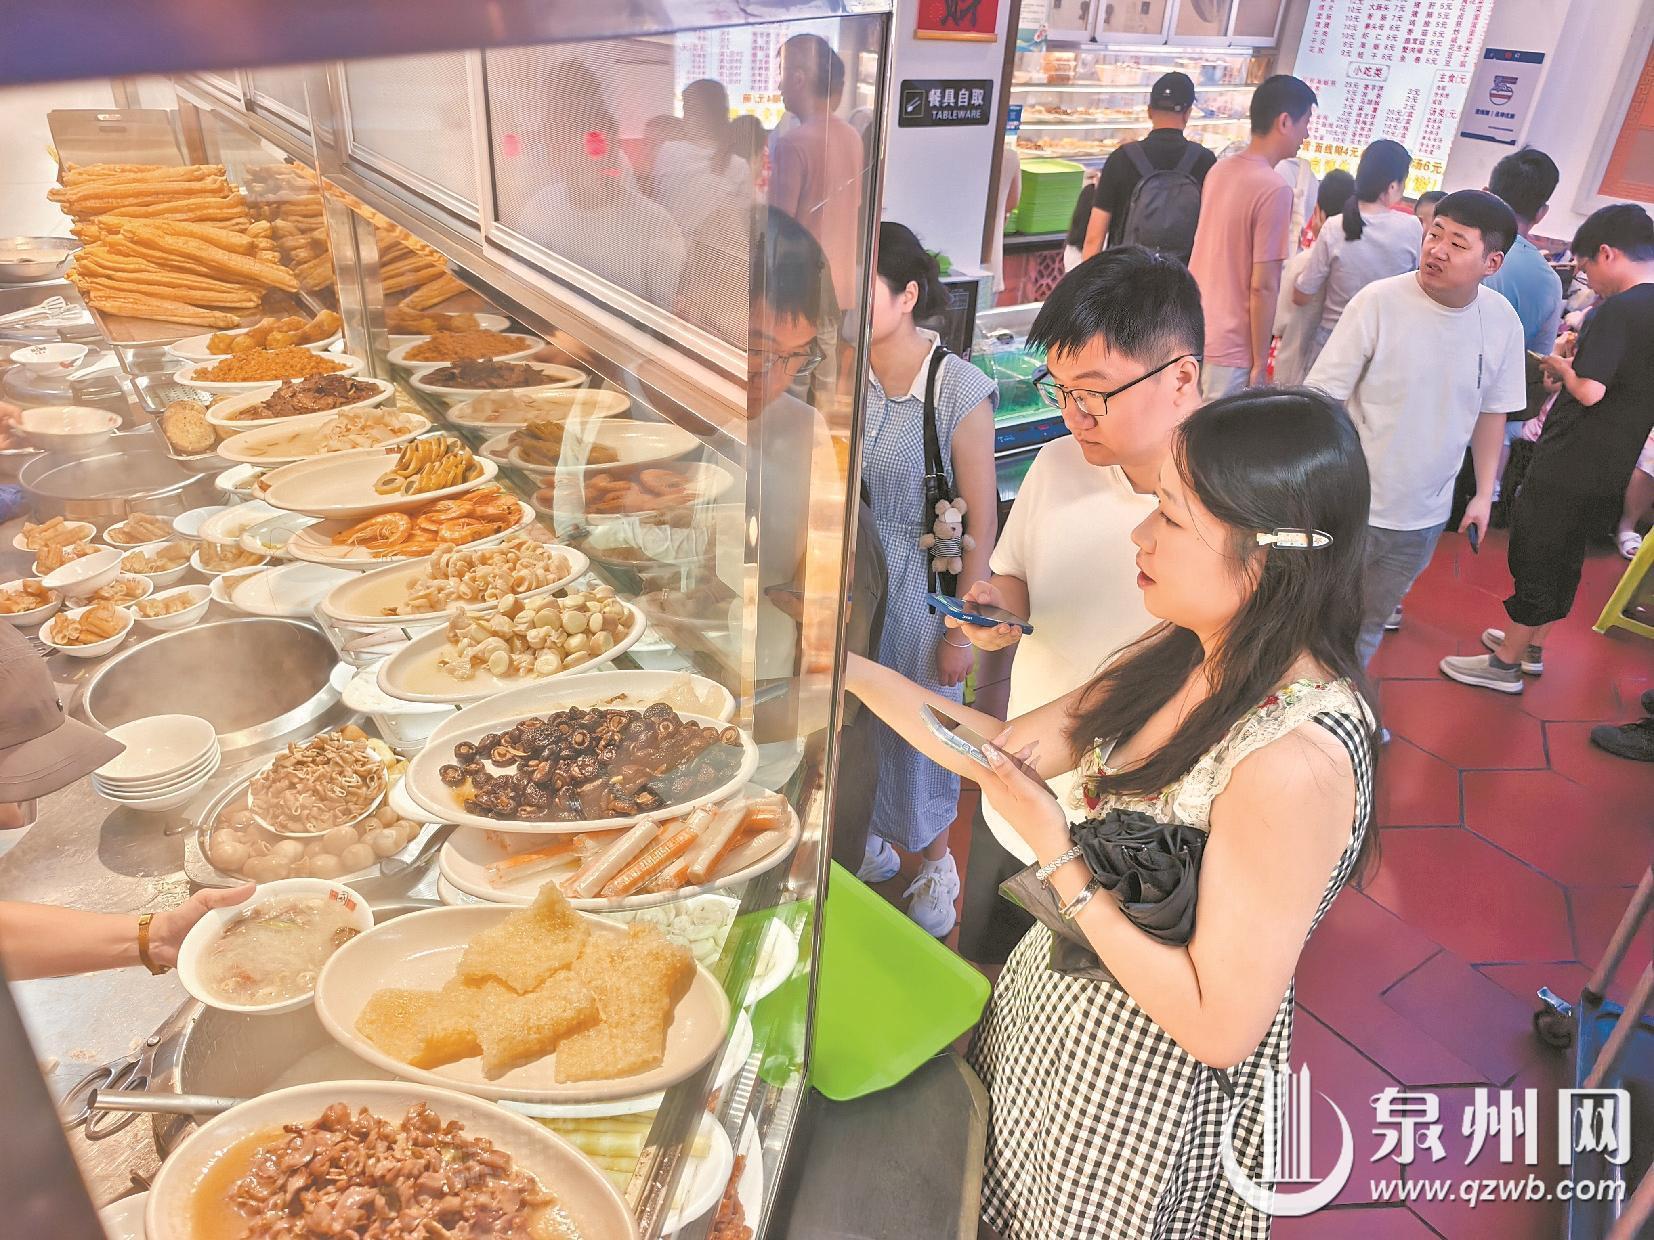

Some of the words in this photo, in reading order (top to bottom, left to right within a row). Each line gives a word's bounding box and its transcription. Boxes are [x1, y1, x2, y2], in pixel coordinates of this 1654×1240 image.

[1440, 3, 1453, 11] 5元
[928, 88, 984, 107] 餐具自取
[931, 110, 981, 120] TABLEWARE
